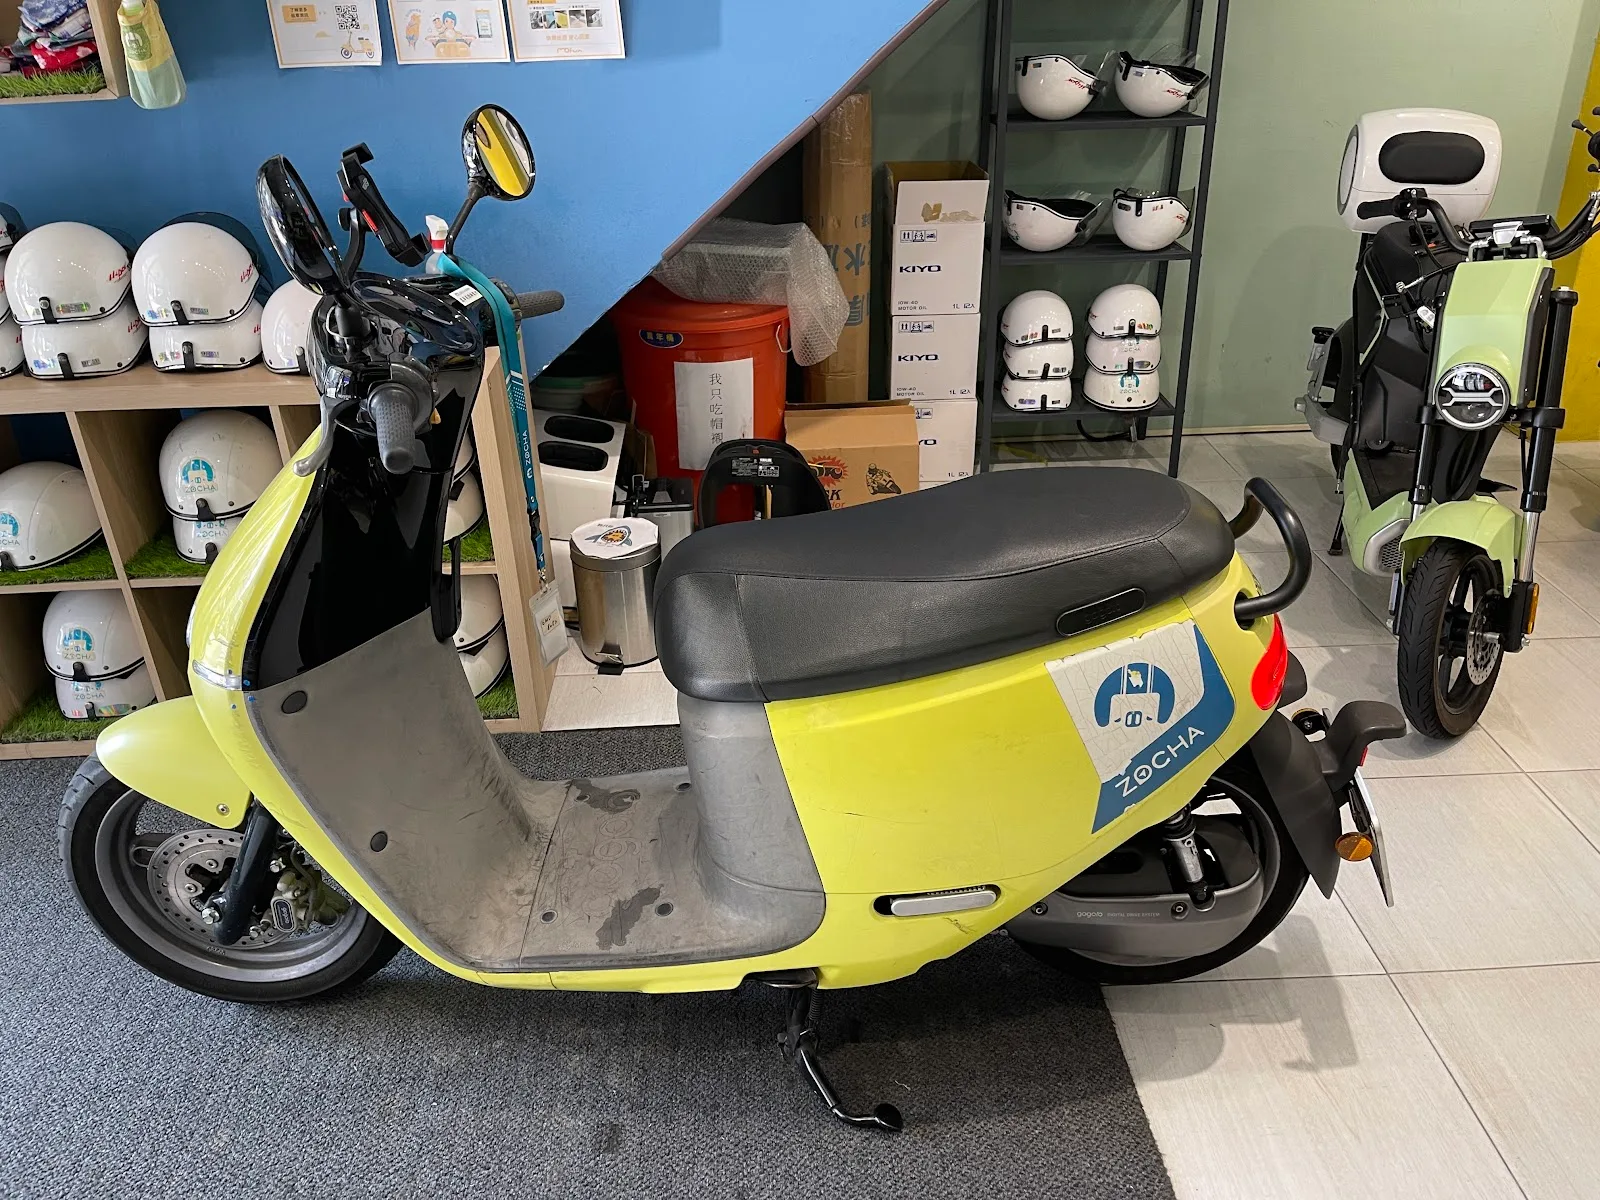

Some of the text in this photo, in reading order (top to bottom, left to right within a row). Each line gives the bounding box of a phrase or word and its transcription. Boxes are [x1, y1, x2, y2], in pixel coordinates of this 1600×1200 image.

[899, 265, 942, 273] KIYO
[522, 430, 532, 465] ZOCHA
[185, 485, 216, 493] ZOCHA
[1115, 726, 1205, 798] ZOCHA
